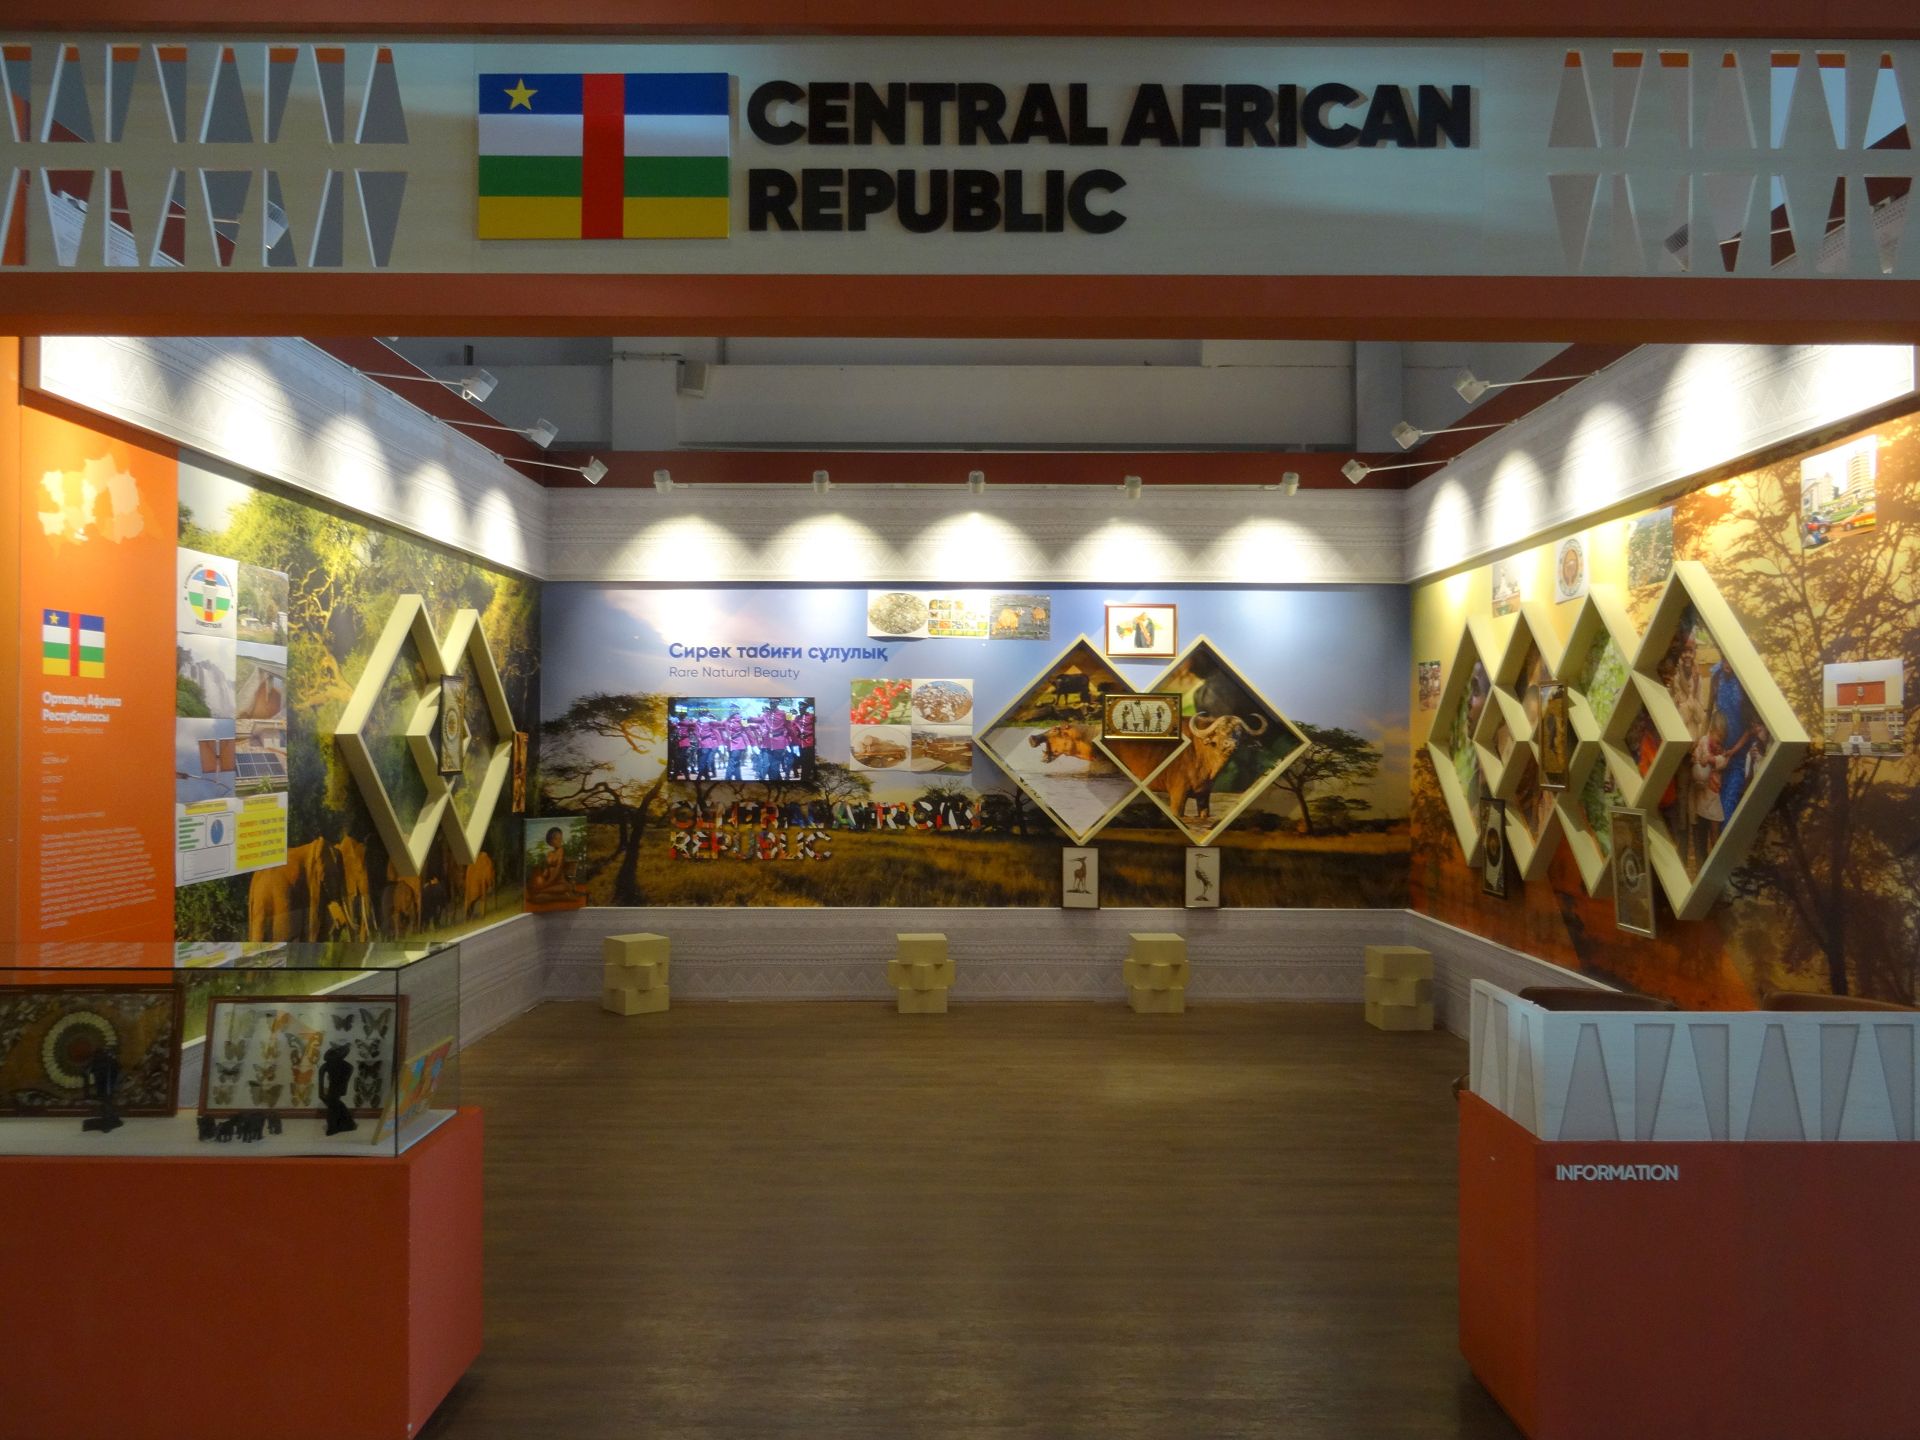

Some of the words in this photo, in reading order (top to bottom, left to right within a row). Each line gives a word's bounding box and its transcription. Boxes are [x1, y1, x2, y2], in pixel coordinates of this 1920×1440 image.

[747, 80, 1108, 146] CENTRAL
[1121, 81, 1471, 148] AFRICAN
[747, 168, 1127, 234] REPUBLIC
[669, 643, 732, 661] Сирек
[737, 643, 802, 659] табиғи
[808, 646, 889, 662] сұлулық
[669, 666, 699, 678] Rare
[702, 666, 750, 678] Natural
[753, 666, 801, 680] Beauty
[670, 831, 832, 860] REPUBLIC
[1556, 1164, 1680, 1181] INFORMATION
